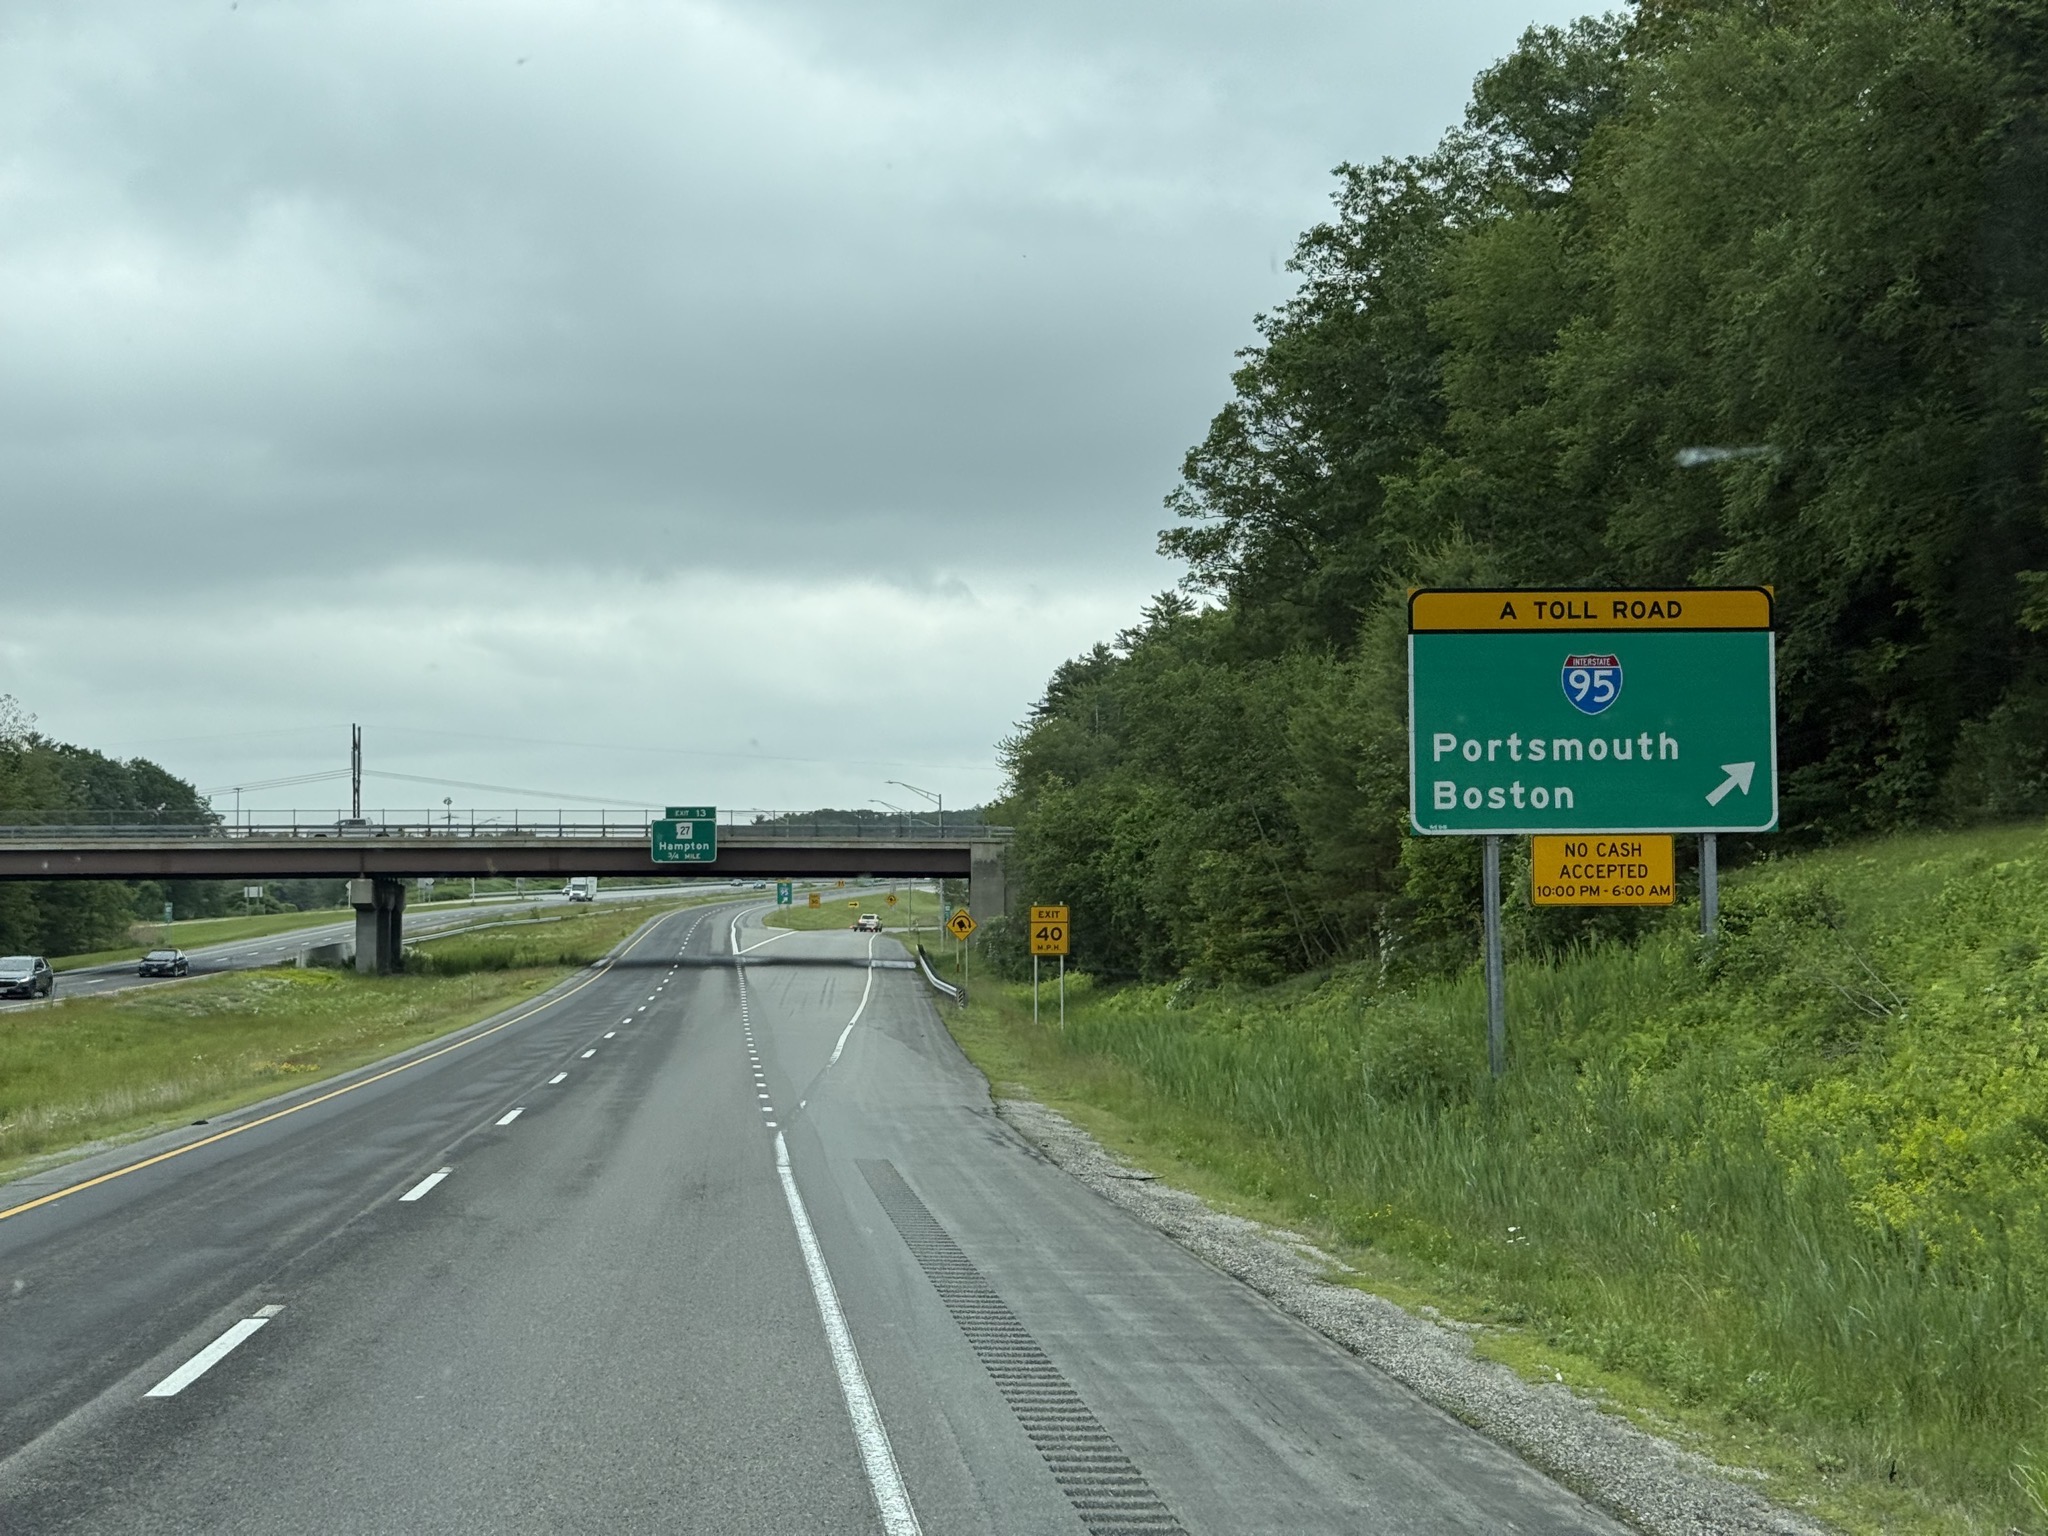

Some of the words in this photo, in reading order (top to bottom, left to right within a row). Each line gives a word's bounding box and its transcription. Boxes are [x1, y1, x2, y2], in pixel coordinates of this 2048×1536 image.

[1499, 601, 1517, 620] A
[1533, 601, 1598, 620] TOLL
[1613, 600, 1683, 619] ROAD
[1572, 657, 1611, 666] INTERSTATE
[1568, 669, 1615, 703] 95
[1432, 731, 1679, 762] Portsmouth
[1433, 780, 1574, 810] Boston
[696, 809, 706, 817] 13
[680, 826, 690, 836] 27
[659, 842, 710, 852] Hampton
[1565, 842, 1588, 858] NO
[1596, 842, 1642, 857] CASH
[1559, 864, 1648, 879] ACCEPTED
[1536, 885, 1575, 897] 10:00
[1580, 885, 1600, 897] PM
[1612, 885, 1645, 897] 6:00
[1649, 885, 1671, 896] AM
[1038, 910, 1060, 919] EXIT
[1035, 926, 1063, 941] 40
